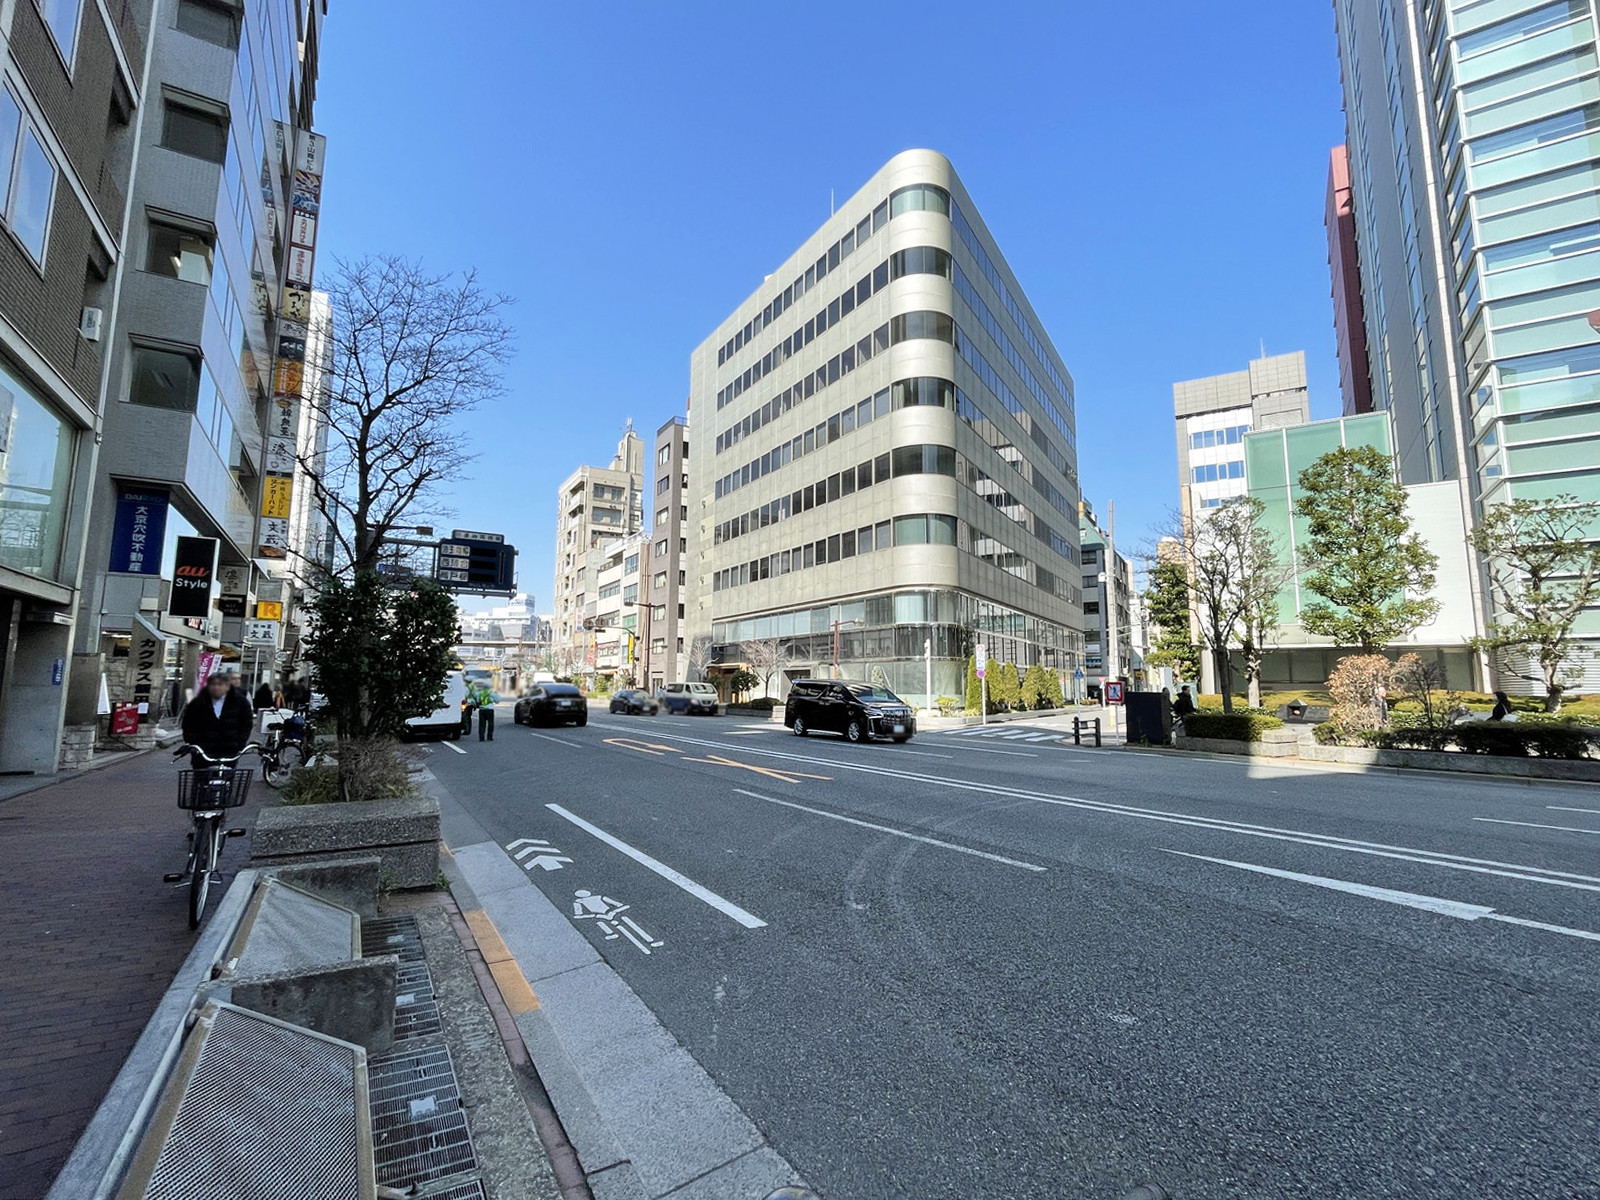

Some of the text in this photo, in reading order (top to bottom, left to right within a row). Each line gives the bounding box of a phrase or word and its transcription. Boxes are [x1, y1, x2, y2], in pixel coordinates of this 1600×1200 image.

[267, 479, 277, 515] リンガーハット
[128, 506, 149, 572] 大京穴吹不動産
[176, 565, 210, 577] au
[175, 578, 208, 589] Style
